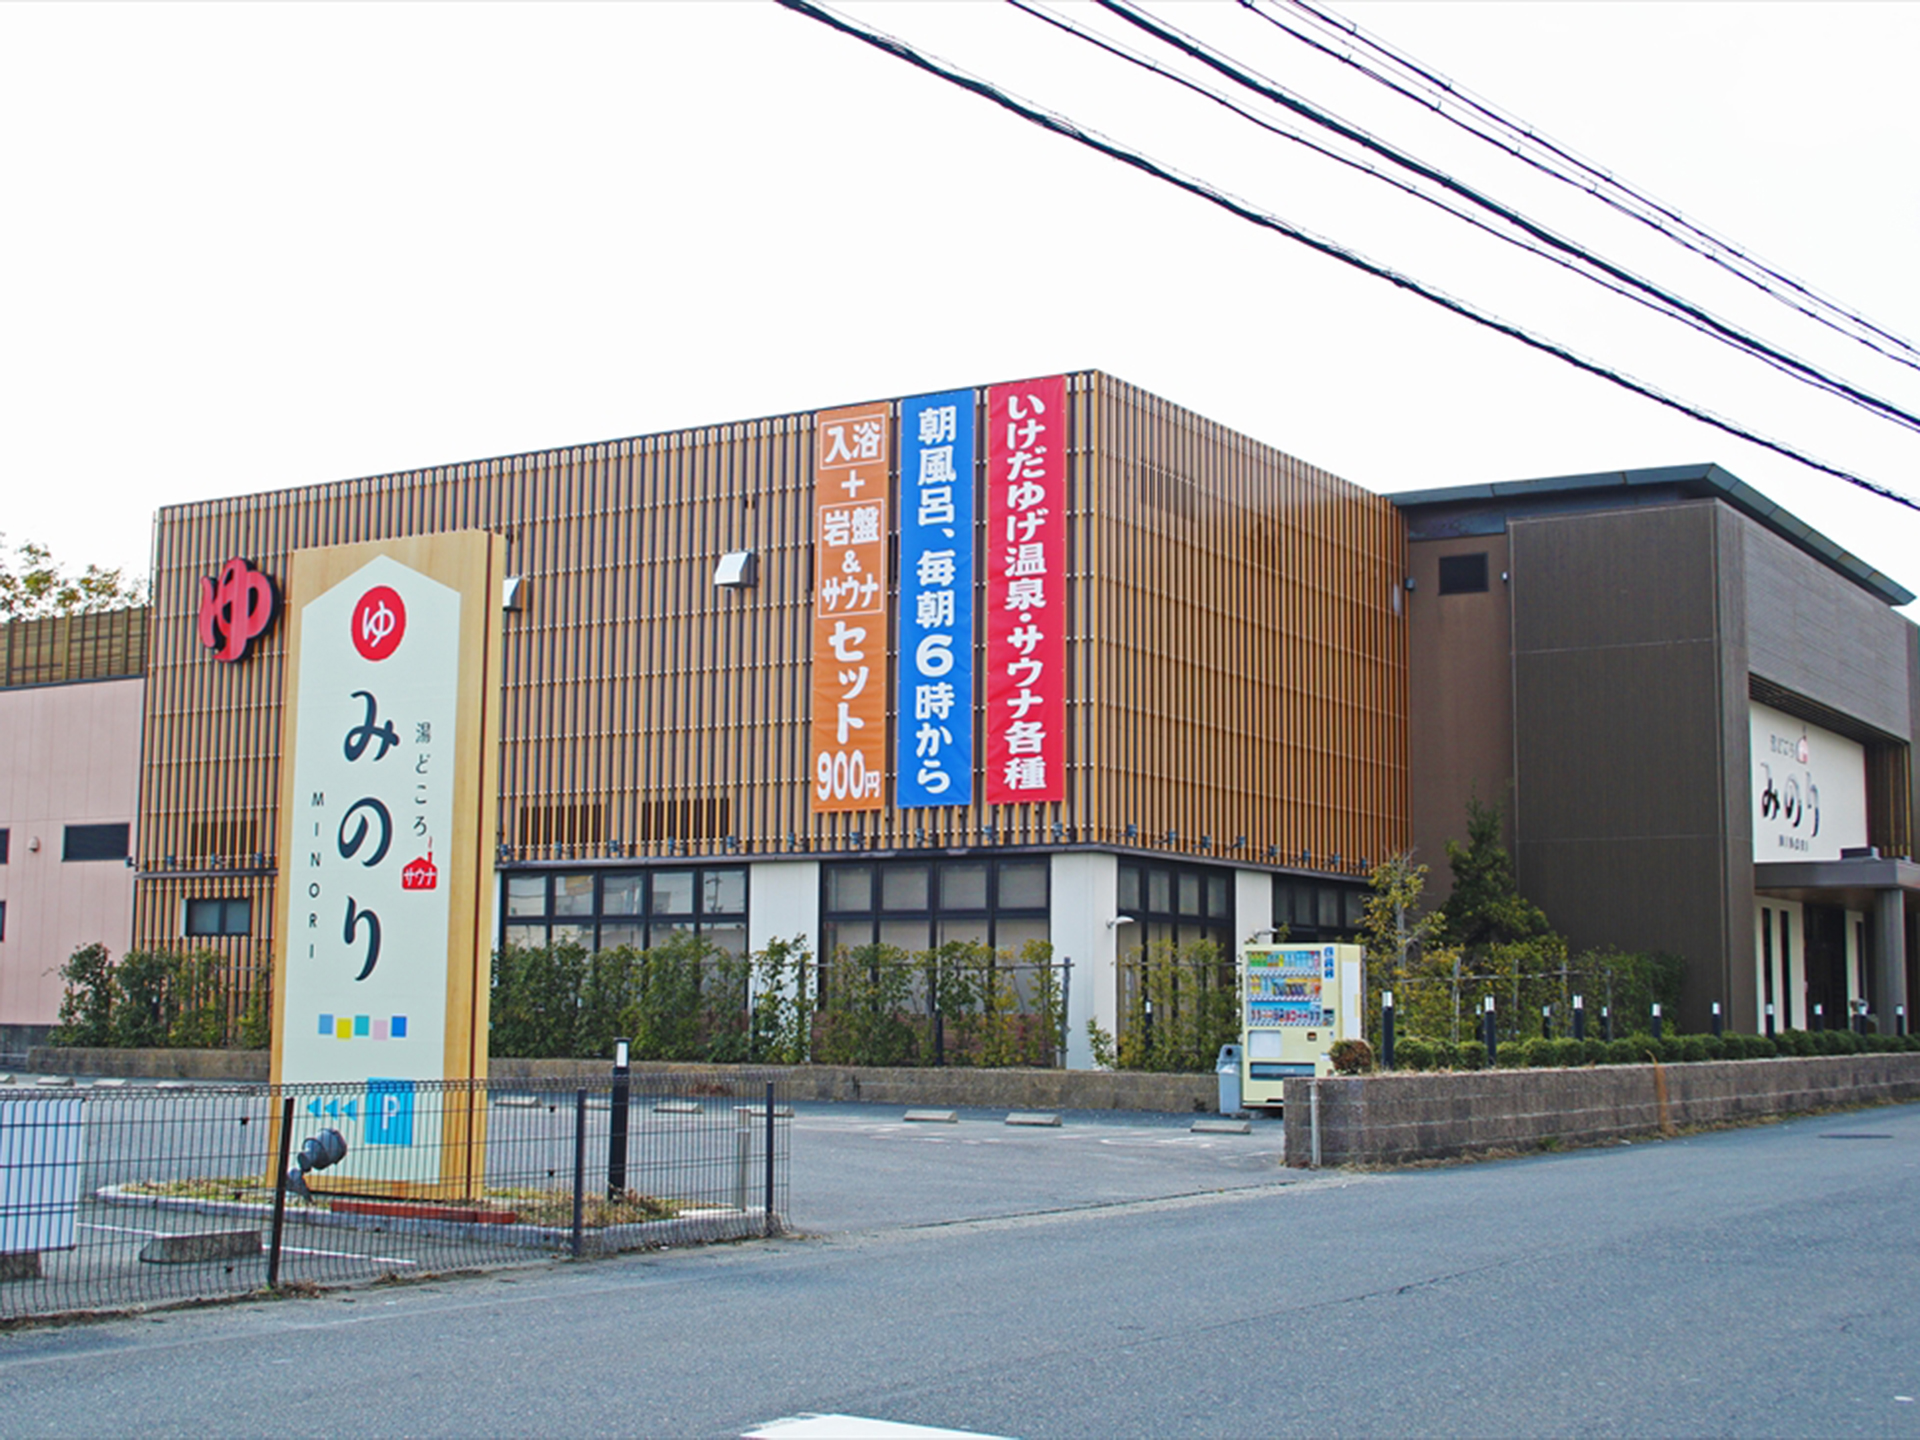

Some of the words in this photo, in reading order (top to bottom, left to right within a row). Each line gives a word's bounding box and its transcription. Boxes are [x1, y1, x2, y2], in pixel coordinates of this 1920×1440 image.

[825, 421, 881, 463] 入浴
[823, 506, 880, 547] 岩盤
[199, 556, 274, 662] ゆ
[362, 600, 396, 648] ゆ
[822, 572, 880, 612] サウナ
[915, 404, 957, 795] 朝風呂、毎朝6時から
[1003, 394, 1049, 791] いけだゆげ温泉・サウナ各種
[828, 621, 870, 745] セット
[413, 721, 431, 837] 湯どころ
[816, 749, 882, 801] 900円
[1760, 762, 1820, 838] みのり
[338, 690, 400, 981] みのり
[309, 791, 324, 959] MINORI
[403, 867, 437, 887] サウナ
[382, 1093, 401, 1131] P
